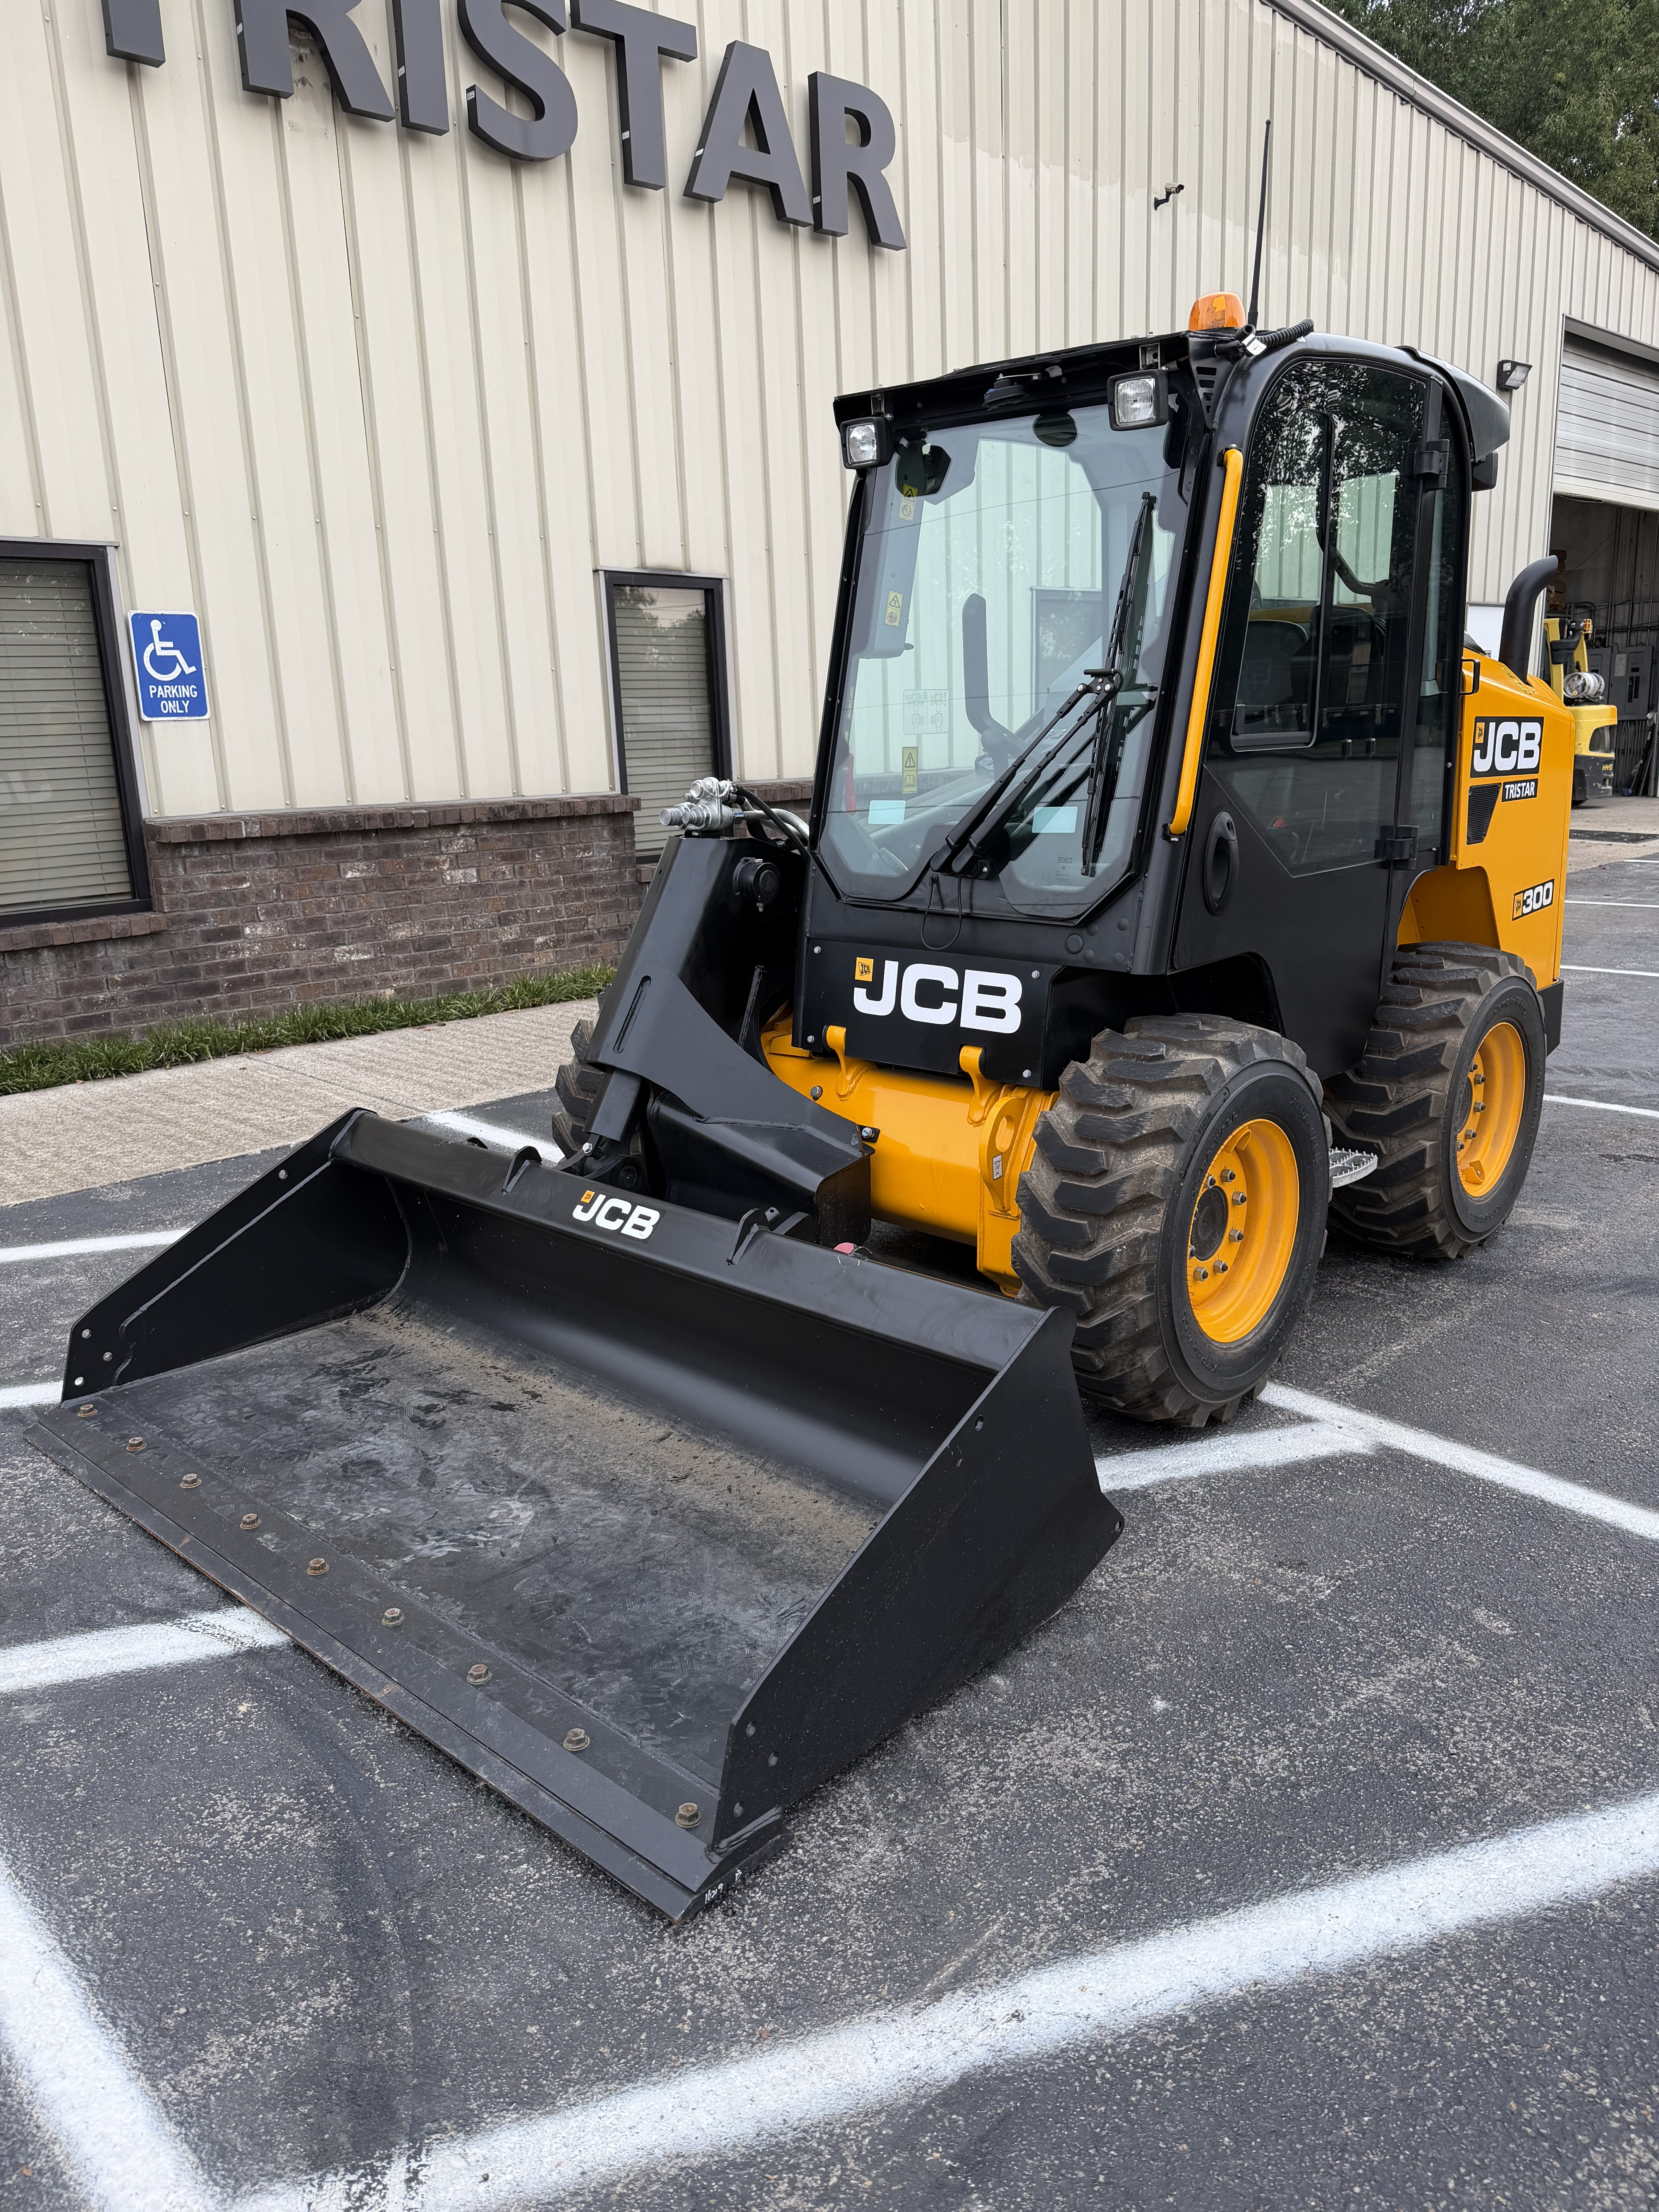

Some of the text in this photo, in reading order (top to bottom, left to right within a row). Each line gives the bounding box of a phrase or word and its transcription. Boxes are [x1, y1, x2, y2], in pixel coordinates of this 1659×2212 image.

[149, 685, 198, 698] PARKING
[160, 700, 189, 713] ONLY
[1474, 721, 1541, 772] JCB
[1505, 783, 1535, 800] TRISTAR
[1523, 881, 1553, 914] 300
[860, 963, 870, 974] JCB
[854, 960, 1022, 1034] JCB
[572, 1194, 660, 1239] JCB
